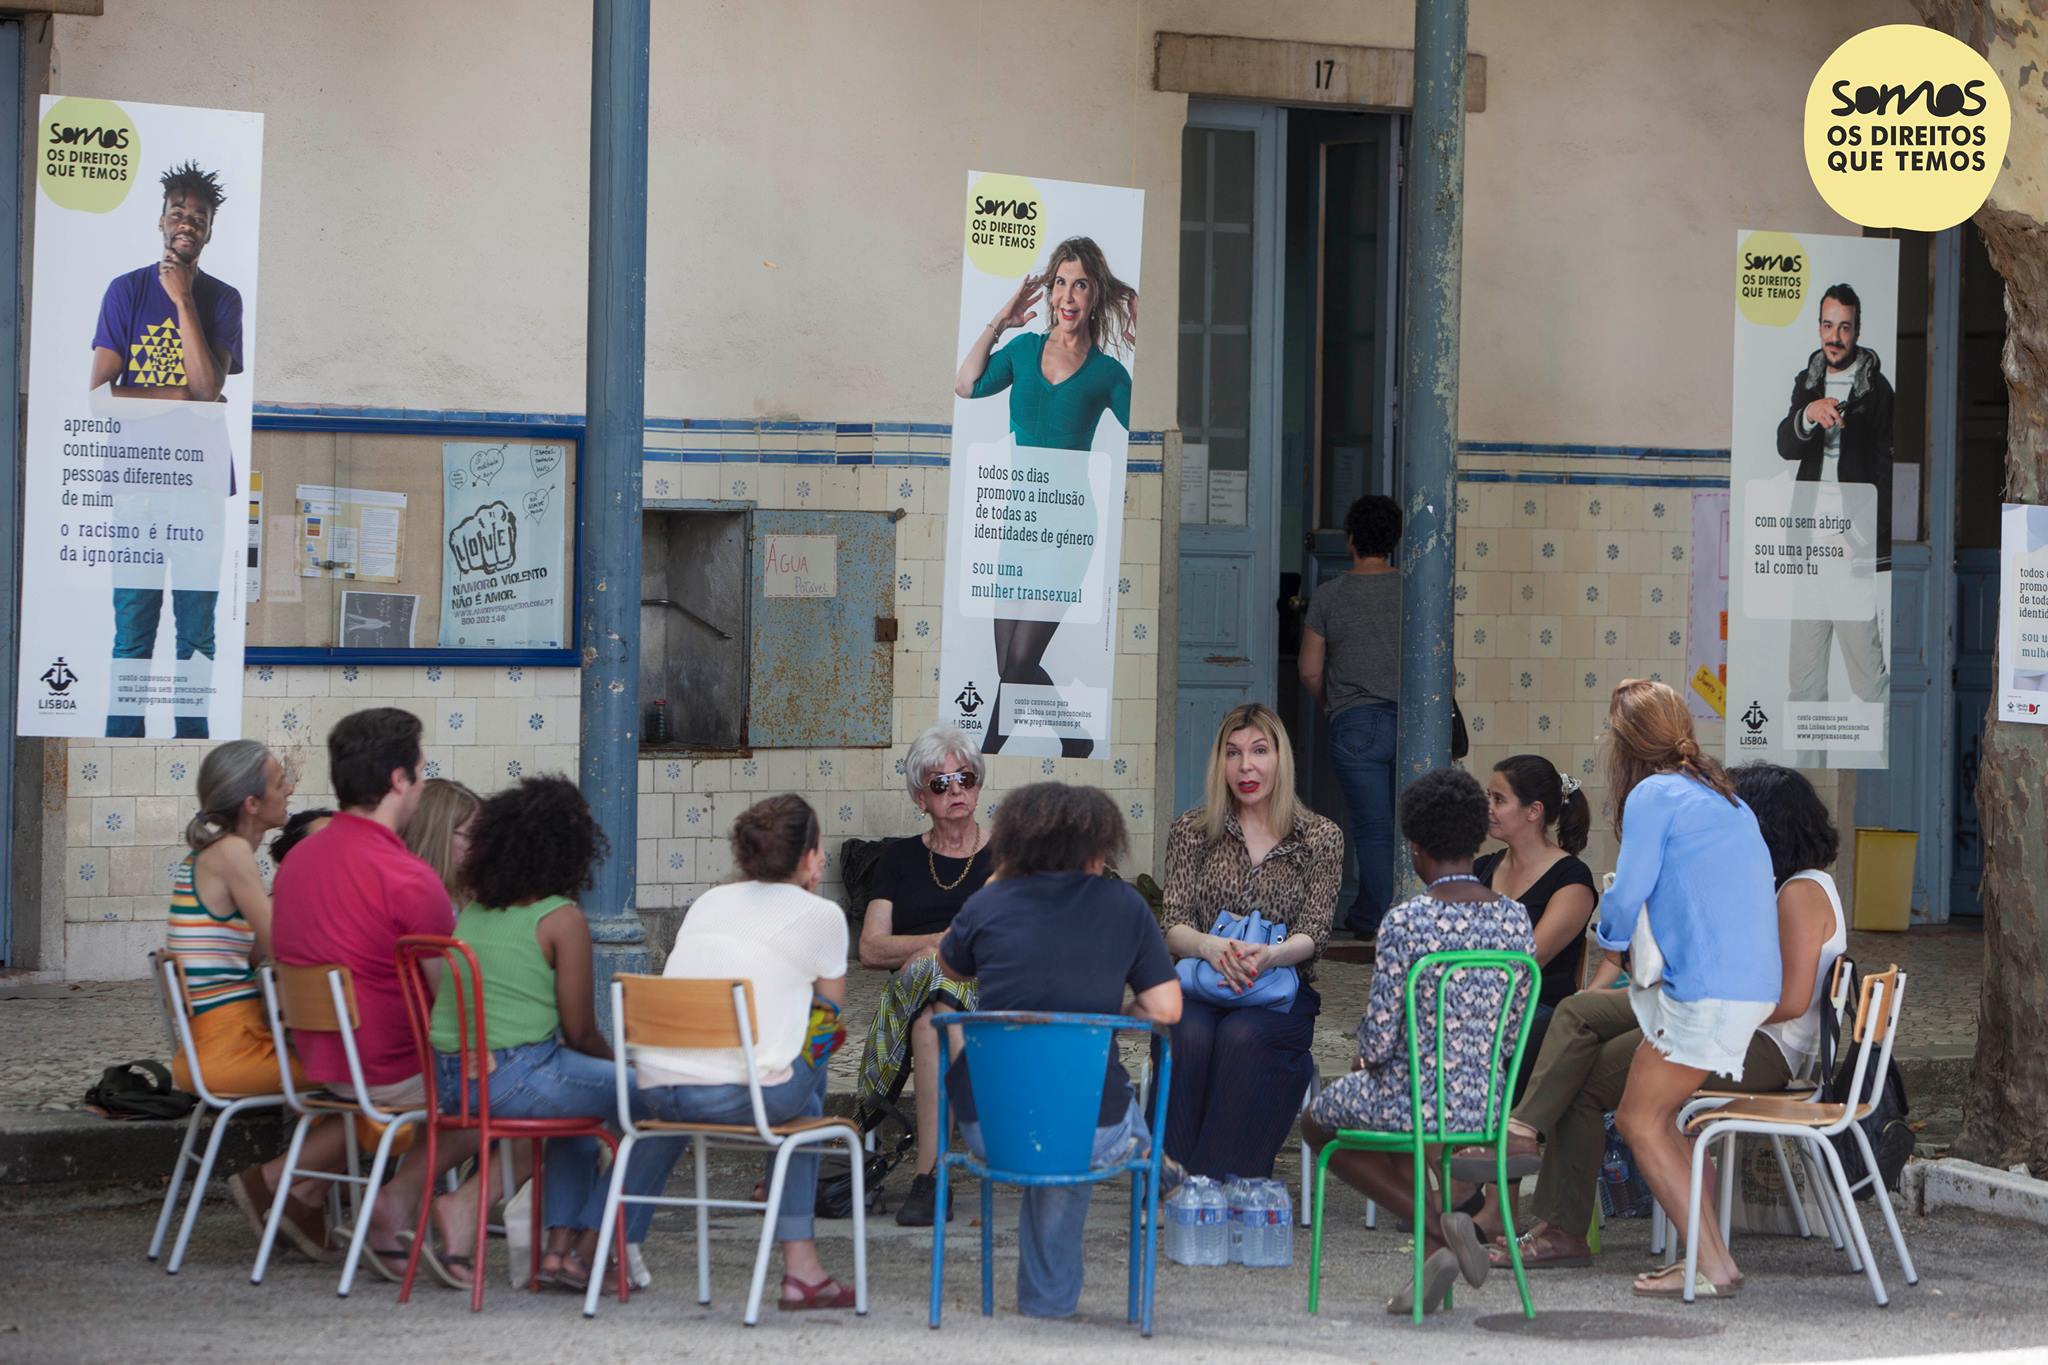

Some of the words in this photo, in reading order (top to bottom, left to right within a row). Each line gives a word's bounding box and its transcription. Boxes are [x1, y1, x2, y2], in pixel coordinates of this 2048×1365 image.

[1315, 60, 1335, 89] 17
[47, 149, 65, 162] OS
[69, 151, 128, 166] DIREITOS
[46, 164, 75, 177] QUE
[82, 166, 127, 181] TEMOS
[972, 219, 987, 231] OS
[990, 221, 1036, 236] DIREITOS
[971, 232, 994, 245] QUE
[999, 235, 1036, 250] TEMOS
[1742, 274, 1755, 285] OS
[1759, 275, 1801, 287] DIREITOS
[1742, 287, 1763, 298] QUE
[1767, 288, 1800, 299] TEMOS
[64, 418, 121, 436] aprendo
[63, 442, 171, 461] continuamente
[175, 449, 204, 462] com
[62, 468, 119, 485] pessoas
[123, 468, 193, 486] diferentes
[978, 465, 1008, 480] todos
[1011, 469, 1024, 482] os
[1027, 467, 1049, 483] dias
[62, 490, 78, 506] de
[82, 491, 114, 507] mim
[977, 486, 1026, 502] promovo
[1028, 491, 1035, 502] a
[1037, 488, 1085, 506] inclusão
[976, 504, 988, 519] de
[991, 506, 1021, 521] todas
[1024, 510, 1037, 522] as
[61, 524, 69, 537] o
[79, 522, 140, 539] racismo
[149, 523, 157, 540] é
[166, 524, 204, 541] fruto
[1755, 516, 1777, 528] com
[1779, 517, 1792, 528] ou
[1795, 517, 1816, 529] sem
[1819, 516, 1851, 533] abrigo
[974, 524, 1038, 543] identidades
[1040, 528, 1053, 543] de
[1056, 529, 1094, 548] género
[456, 529, 506, 562] LOVE
[1754, 543, 1775, 555] sou
[1778, 544, 1802, 556] uma
[1805, 545, 1844, 560] pessoa
[60, 546, 77, 562] da
[82, 546, 164, 566] ignorância
[766, 538, 809, 575] ÁGUA
[972, 562, 993, 575] sou
[997, 563, 1023, 576] uma
[1755, 559, 1770, 574] tal
[1773, 562, 1803, 574] como
[1807, 562, 1818, 575] tu
[2020, 568, 2044, 578] todos
[453, 578, 498, 596] NAMORO
[501, 567, 547, 585] VIOLENTO
[452, 596, 472, 609] NÃO
[475, 593, 482, 605] É
[484, 590, 516, 603] AMOR.
[971, 583, 1014, 599] mulher
[1017, 585, 1082, 603] transexual
[2019, 594, 2030, 604] de
[476, 616, 490, 624] 202
[491, 615, 506, 623] 148
[2022, 633, 2038, 642] sou
[39, 700, 76, 710] LISBOA
[953, 719, 983, 730] LISBOA
[1740, 736, 1768, 745] LISBOA
